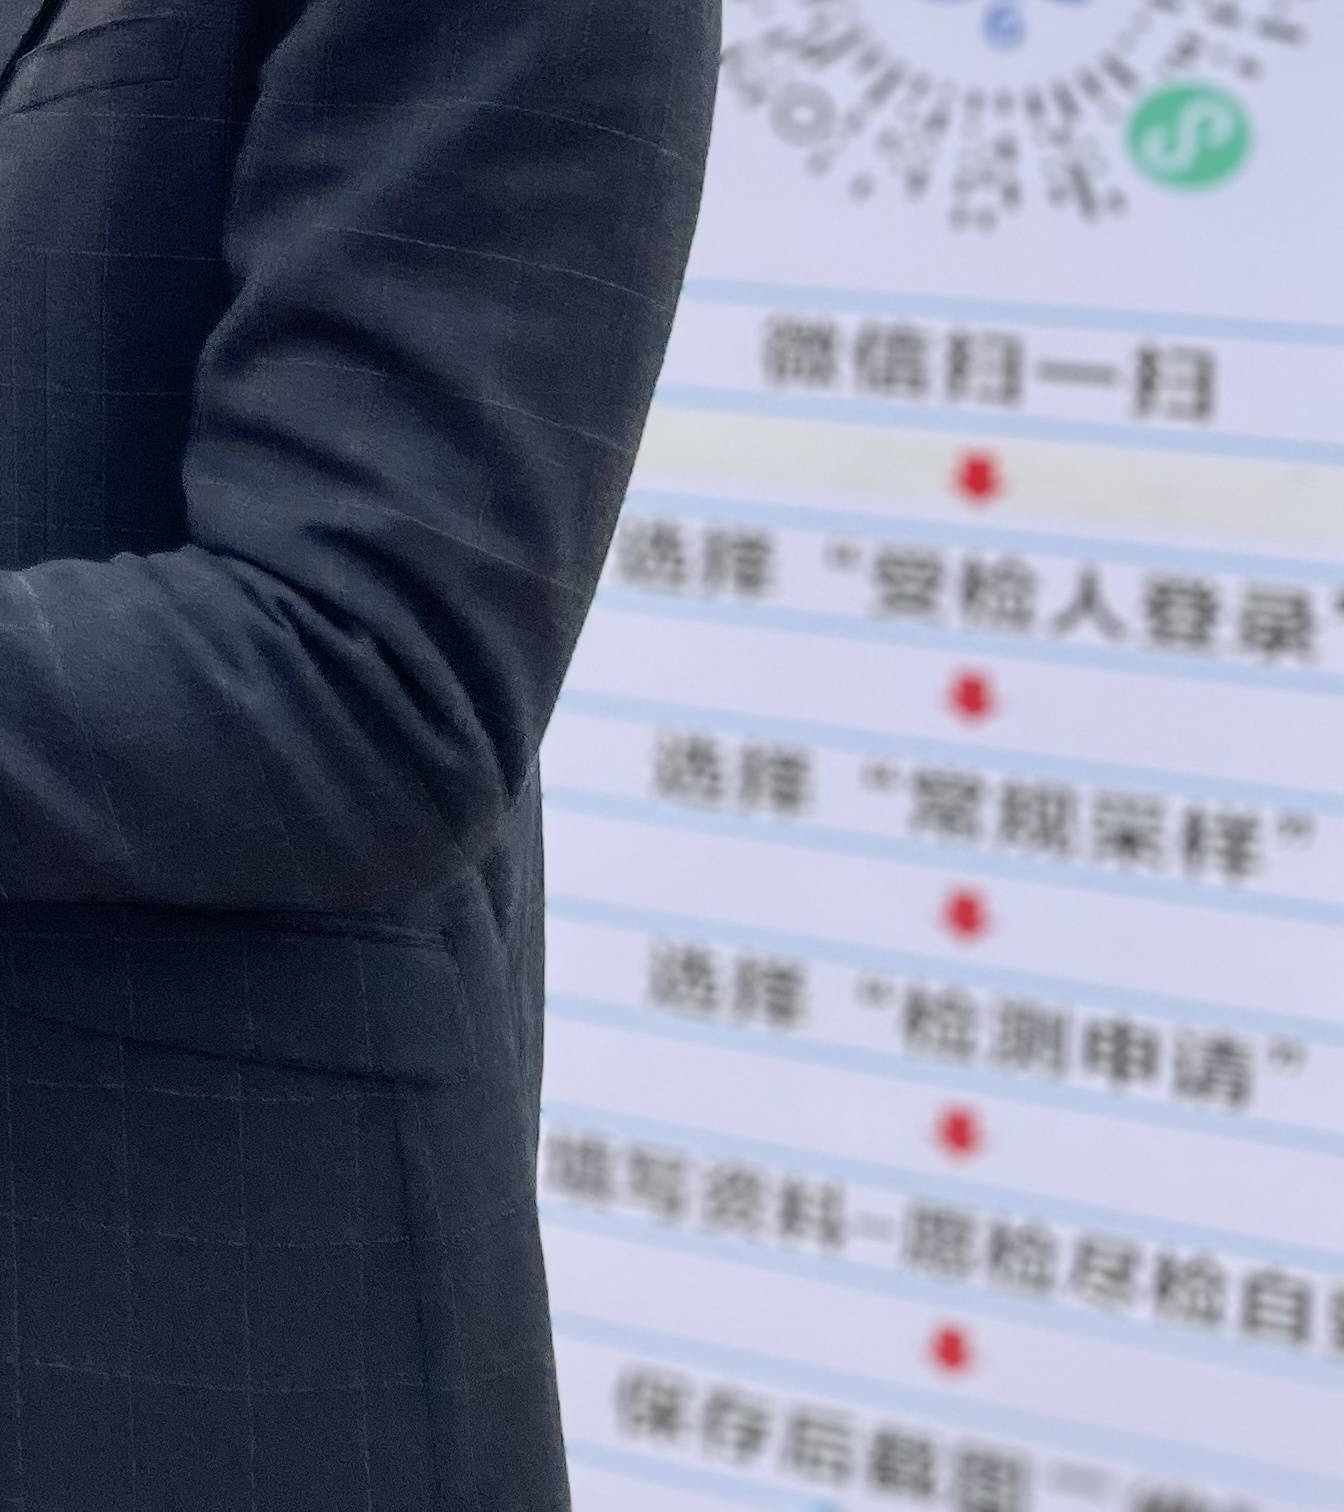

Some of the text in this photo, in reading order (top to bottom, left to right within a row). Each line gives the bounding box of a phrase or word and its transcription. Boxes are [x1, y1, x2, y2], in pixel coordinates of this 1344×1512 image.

[762, 312, 1216, 422] 微信扫一扫
